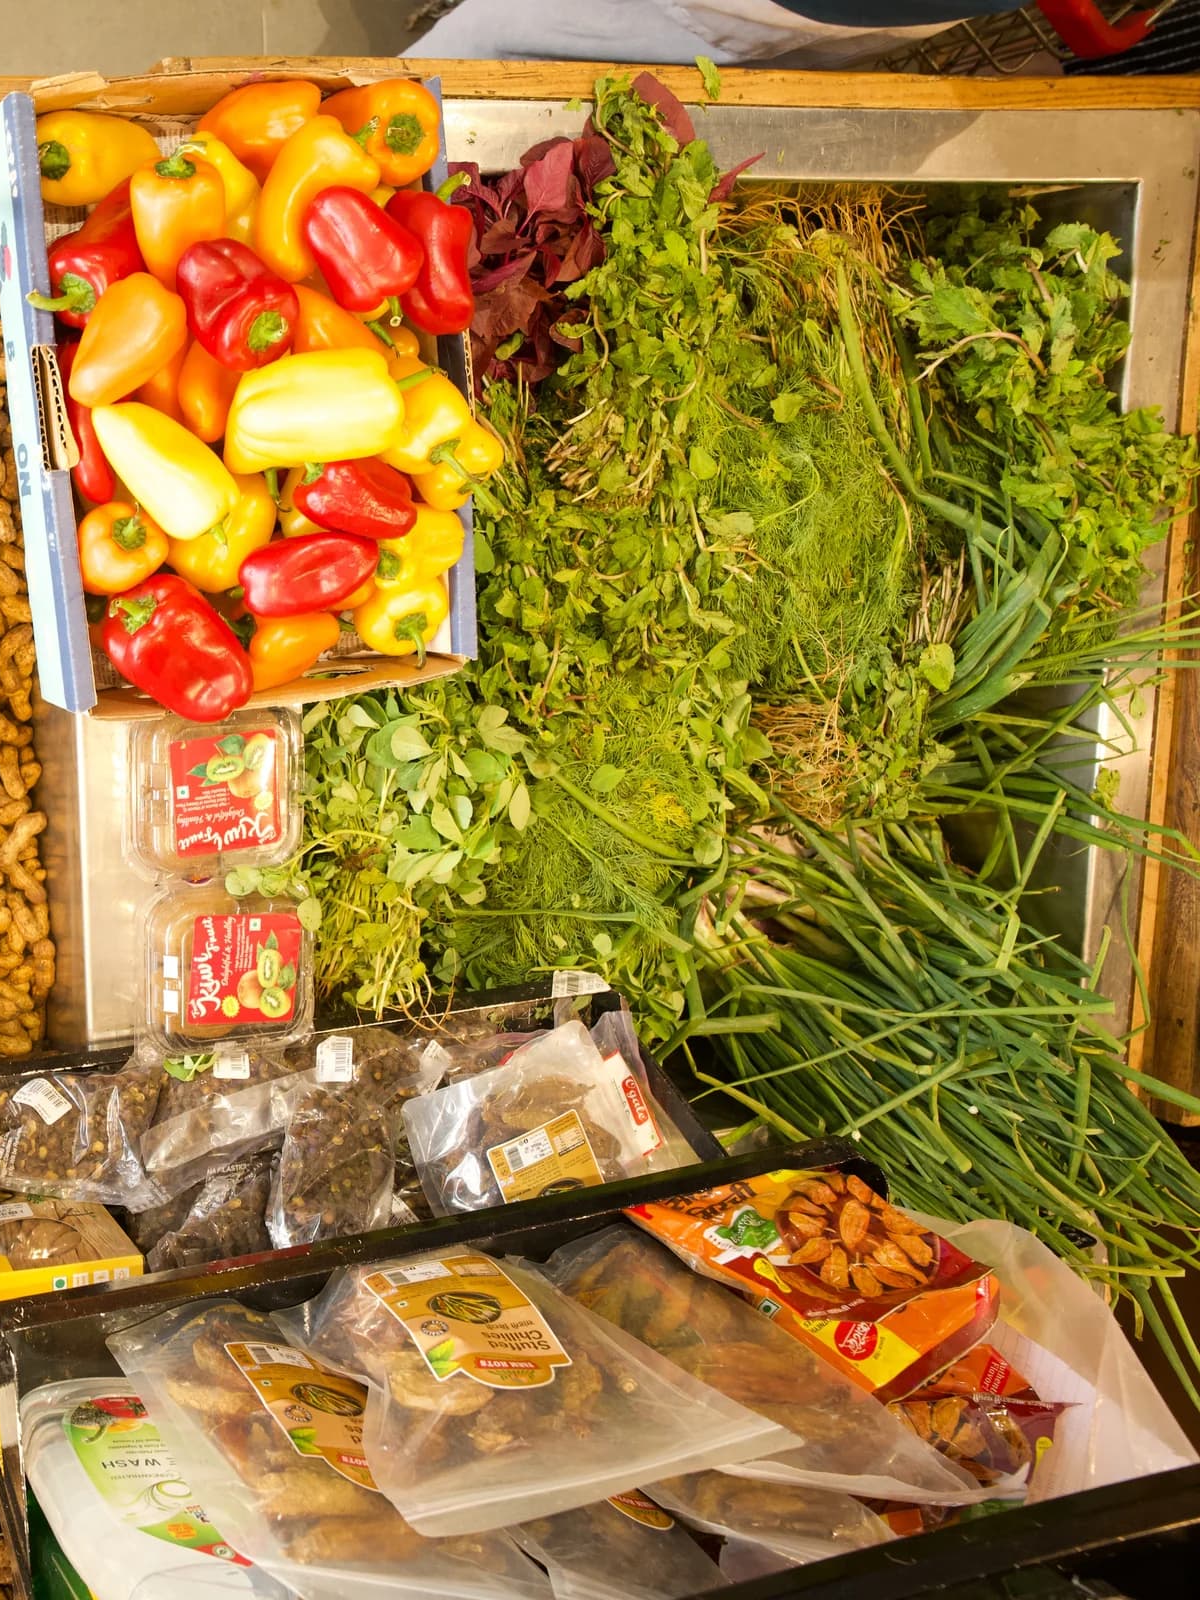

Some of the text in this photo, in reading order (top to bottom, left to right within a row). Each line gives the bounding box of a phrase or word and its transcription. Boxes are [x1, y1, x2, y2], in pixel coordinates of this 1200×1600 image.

[178, 812, 274, 851] Kiwi Fruit
[194, 916, 221, 1017] Kiwi Fruit
[481, 1329, 543, 1342] Chillies
[487, 1339, 551, 1351] Stuffed
[101, 1458, 161, 1470] WASH
